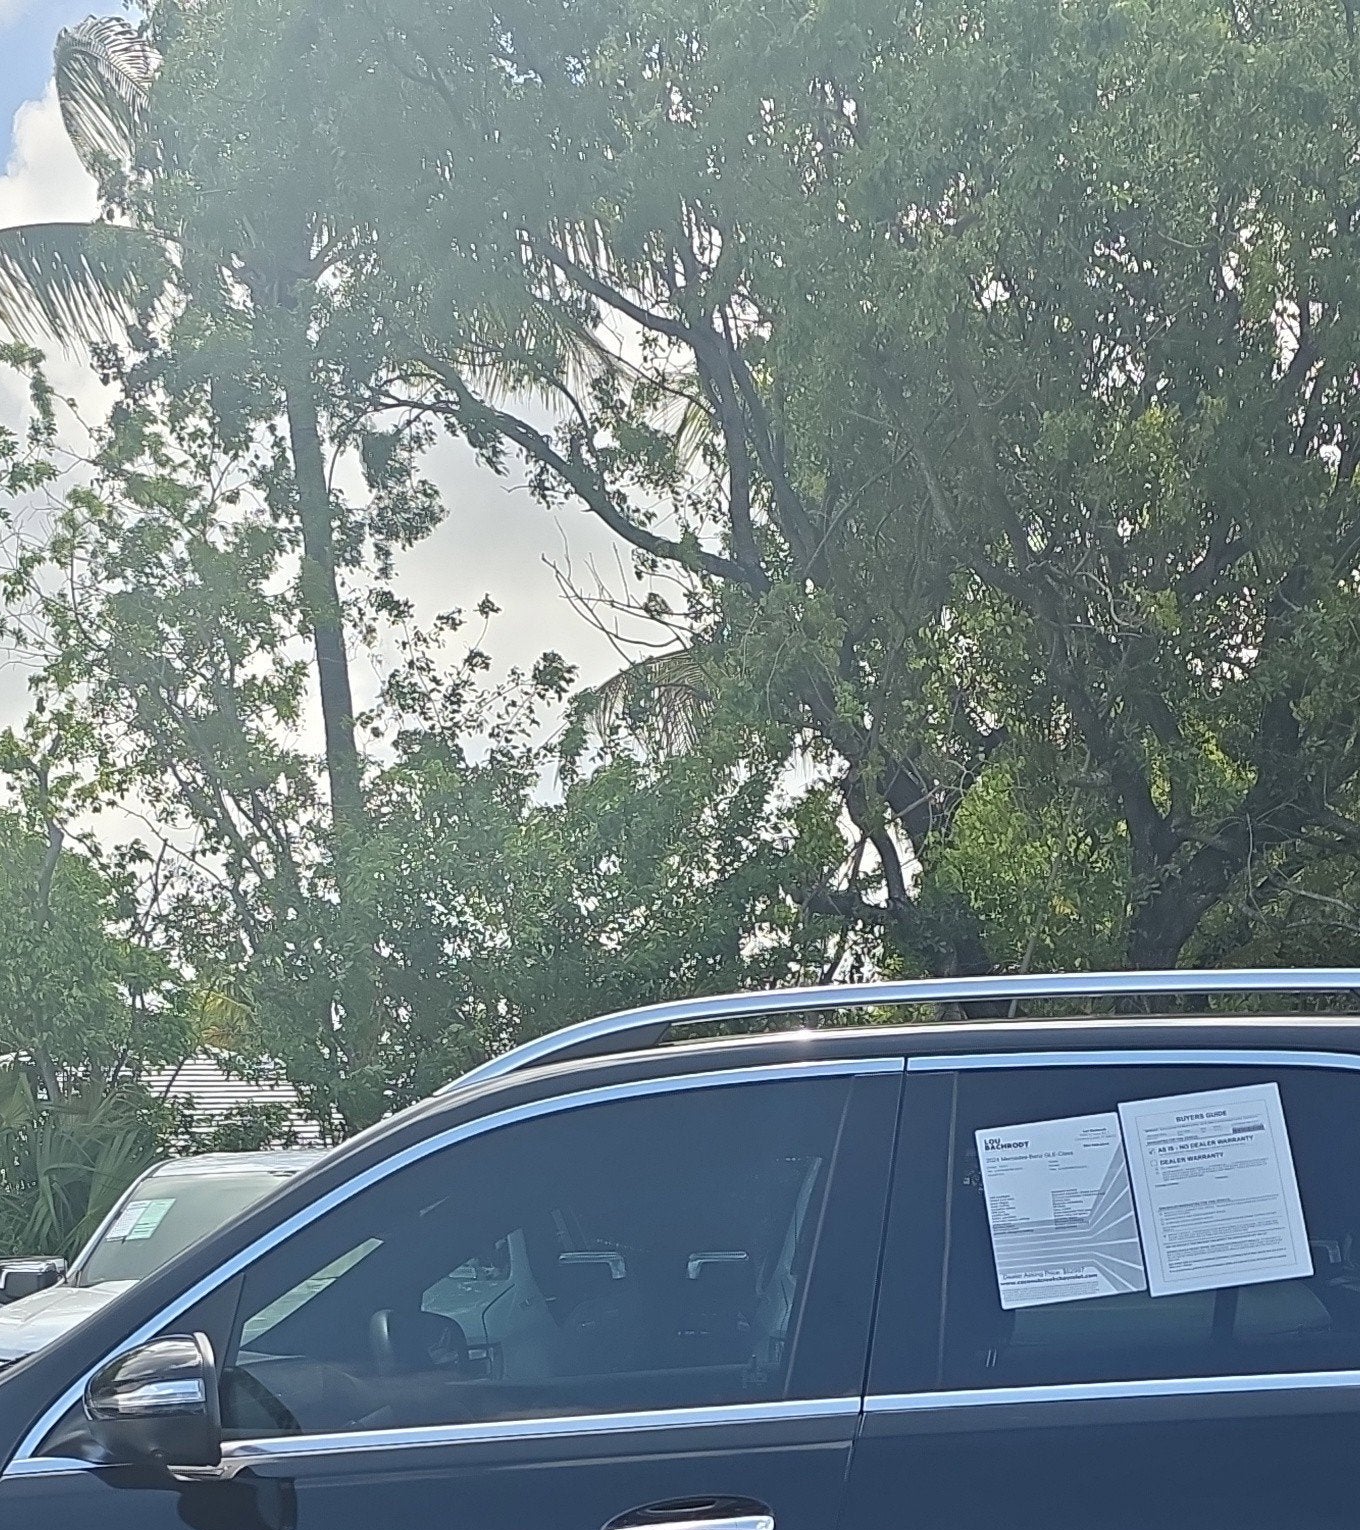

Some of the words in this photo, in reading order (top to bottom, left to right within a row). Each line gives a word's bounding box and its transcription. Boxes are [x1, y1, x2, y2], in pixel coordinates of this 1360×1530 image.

[1176, 1113, 1204, 1122] BUYERS
[1206, 1110, 1227, 1118] GUIDE
[985, 1141, 1029, 1151] BACHRODT
[1190, 1140, 1217, 1149] DEALER
[1217, 1135, 1254, 1144] WARRANTY
[1160, 1156, 1186, 1165] DEALER
[1186, 1152, 1224, 1162] WARRANTY
